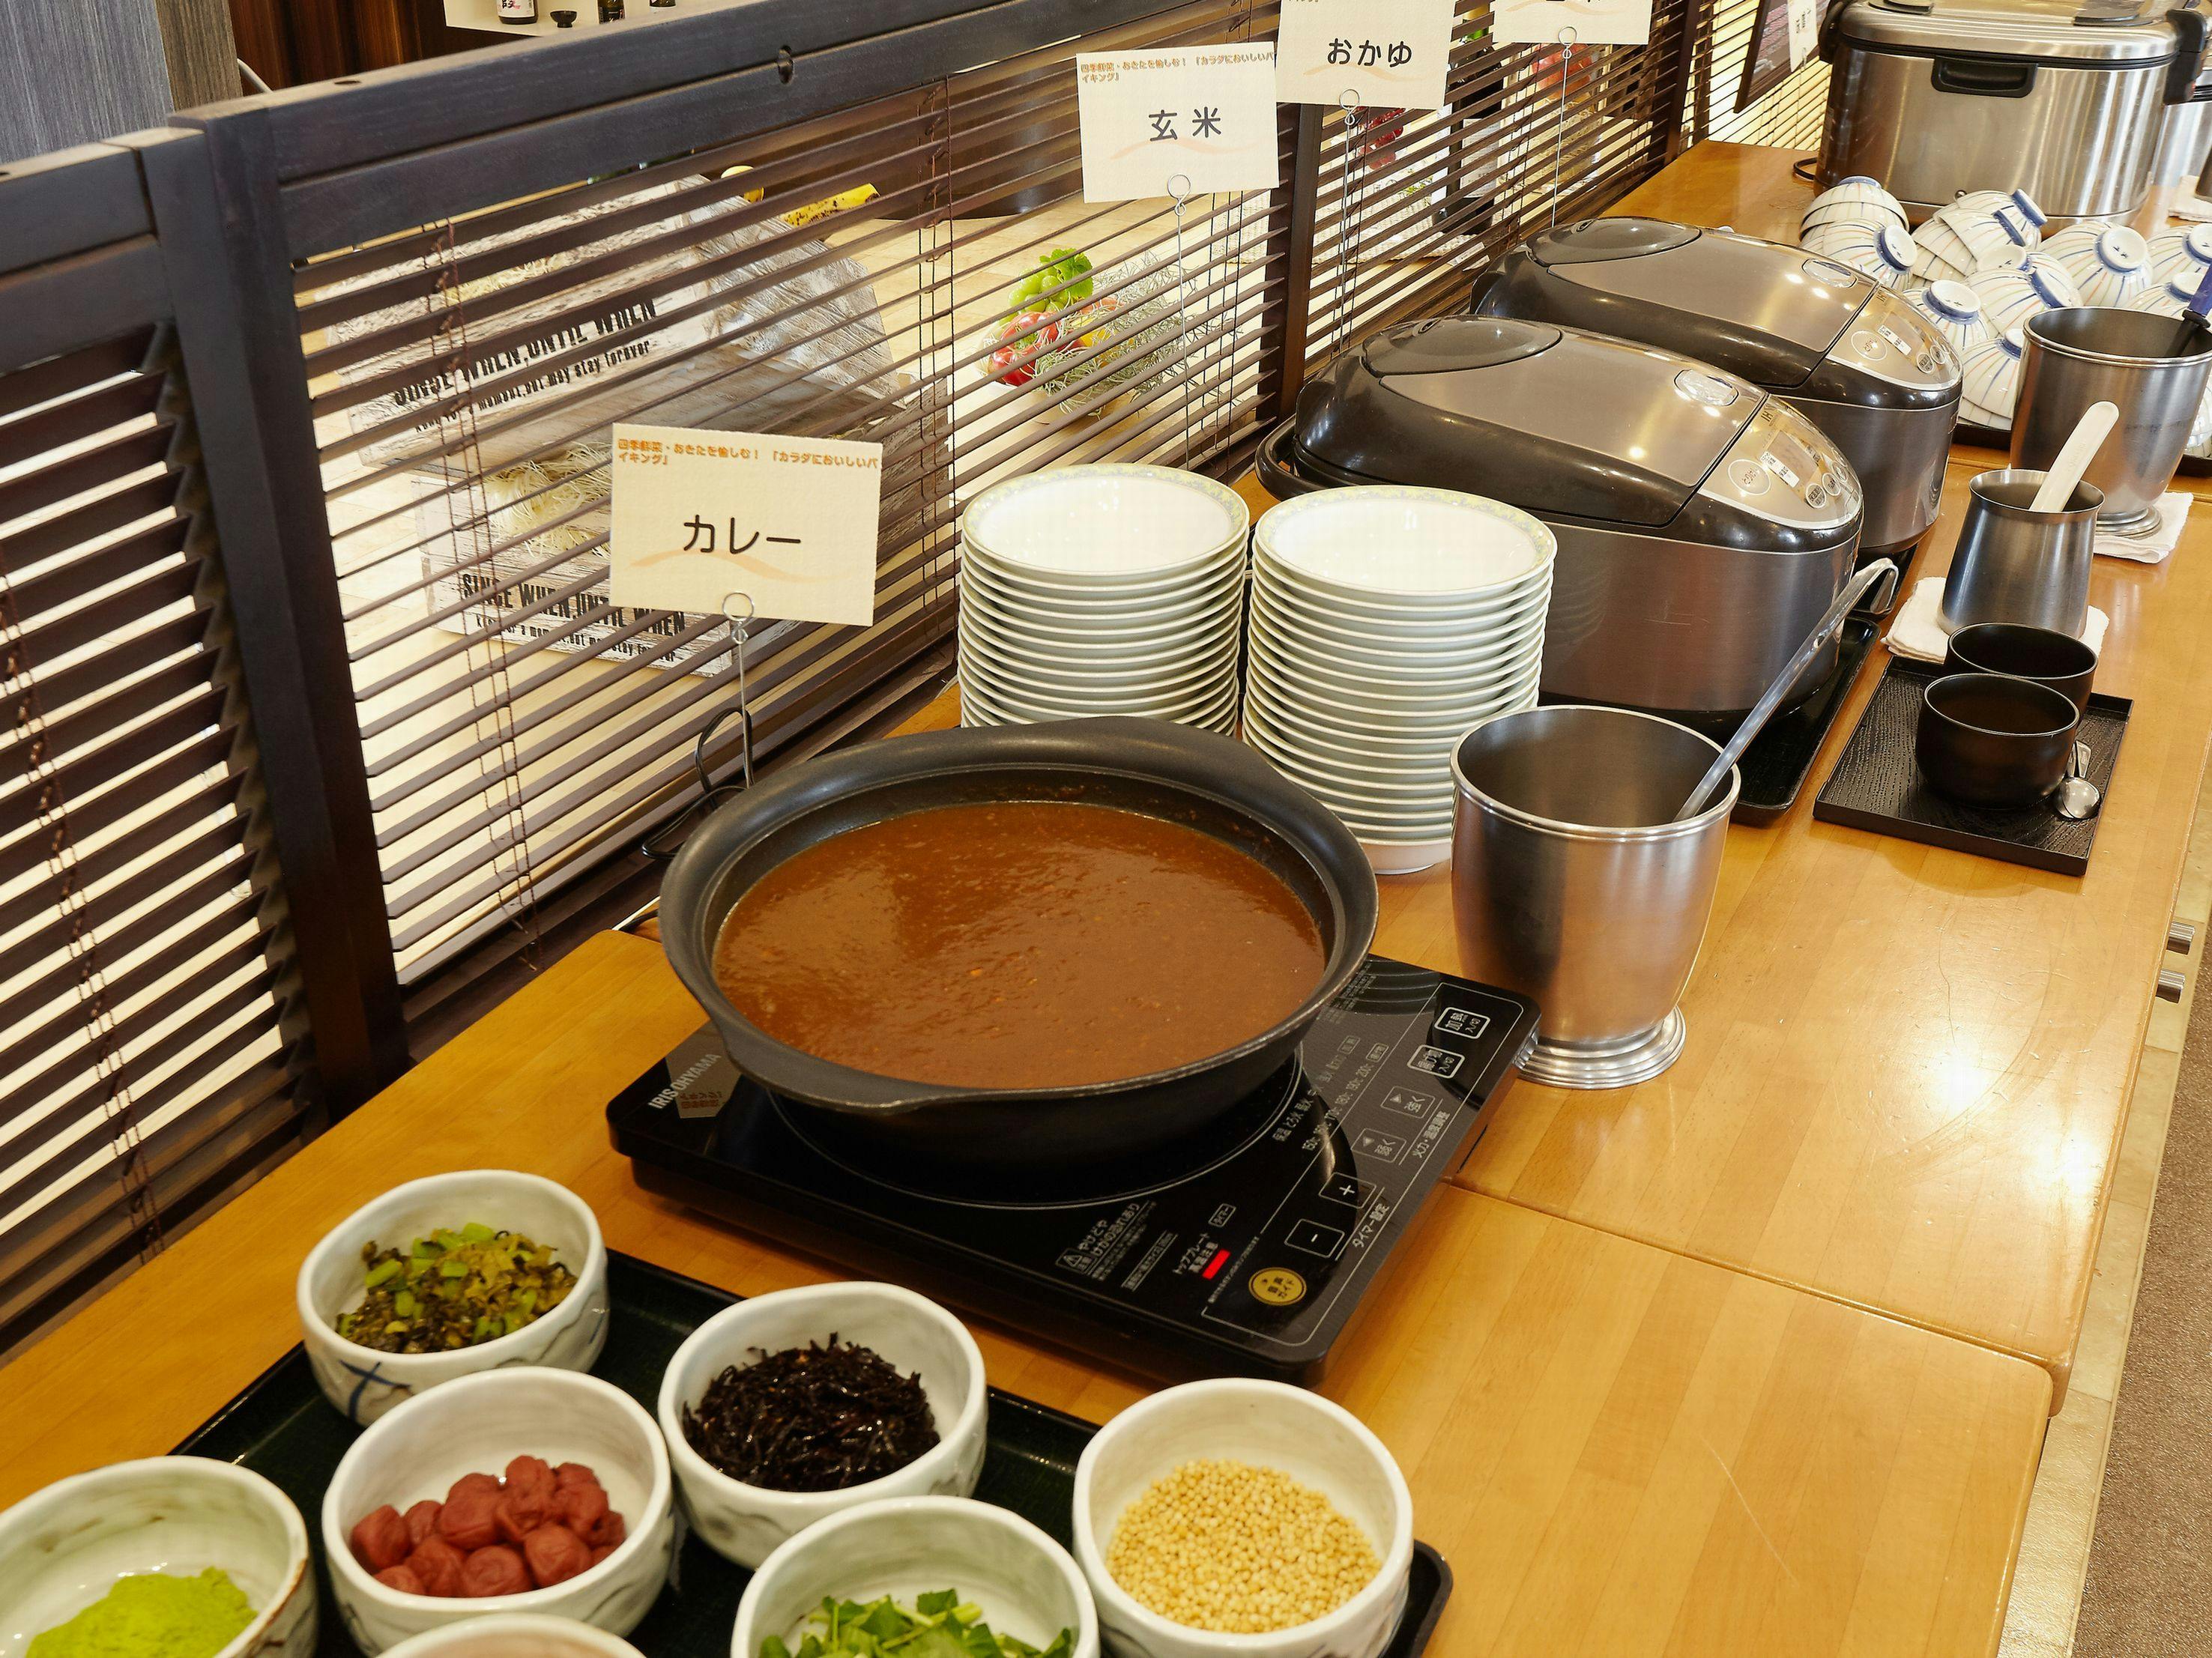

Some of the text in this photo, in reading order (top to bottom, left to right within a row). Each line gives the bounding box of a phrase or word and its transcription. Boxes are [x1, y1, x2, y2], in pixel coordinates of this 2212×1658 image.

[1327, 37, 1412, 68] おかゆ
[1149, 106, 1221, 142] 玄米
[575, 356, 601, 378] stay
[1760, 411, 1774, 423] IH
[683, 514, 802, 554] カレー
[1445, 1011, 1469, 1031] 加熱
[647, 1089, 679, 1109] IRIS
[1404, 1095, 1425, 1113] 強く
